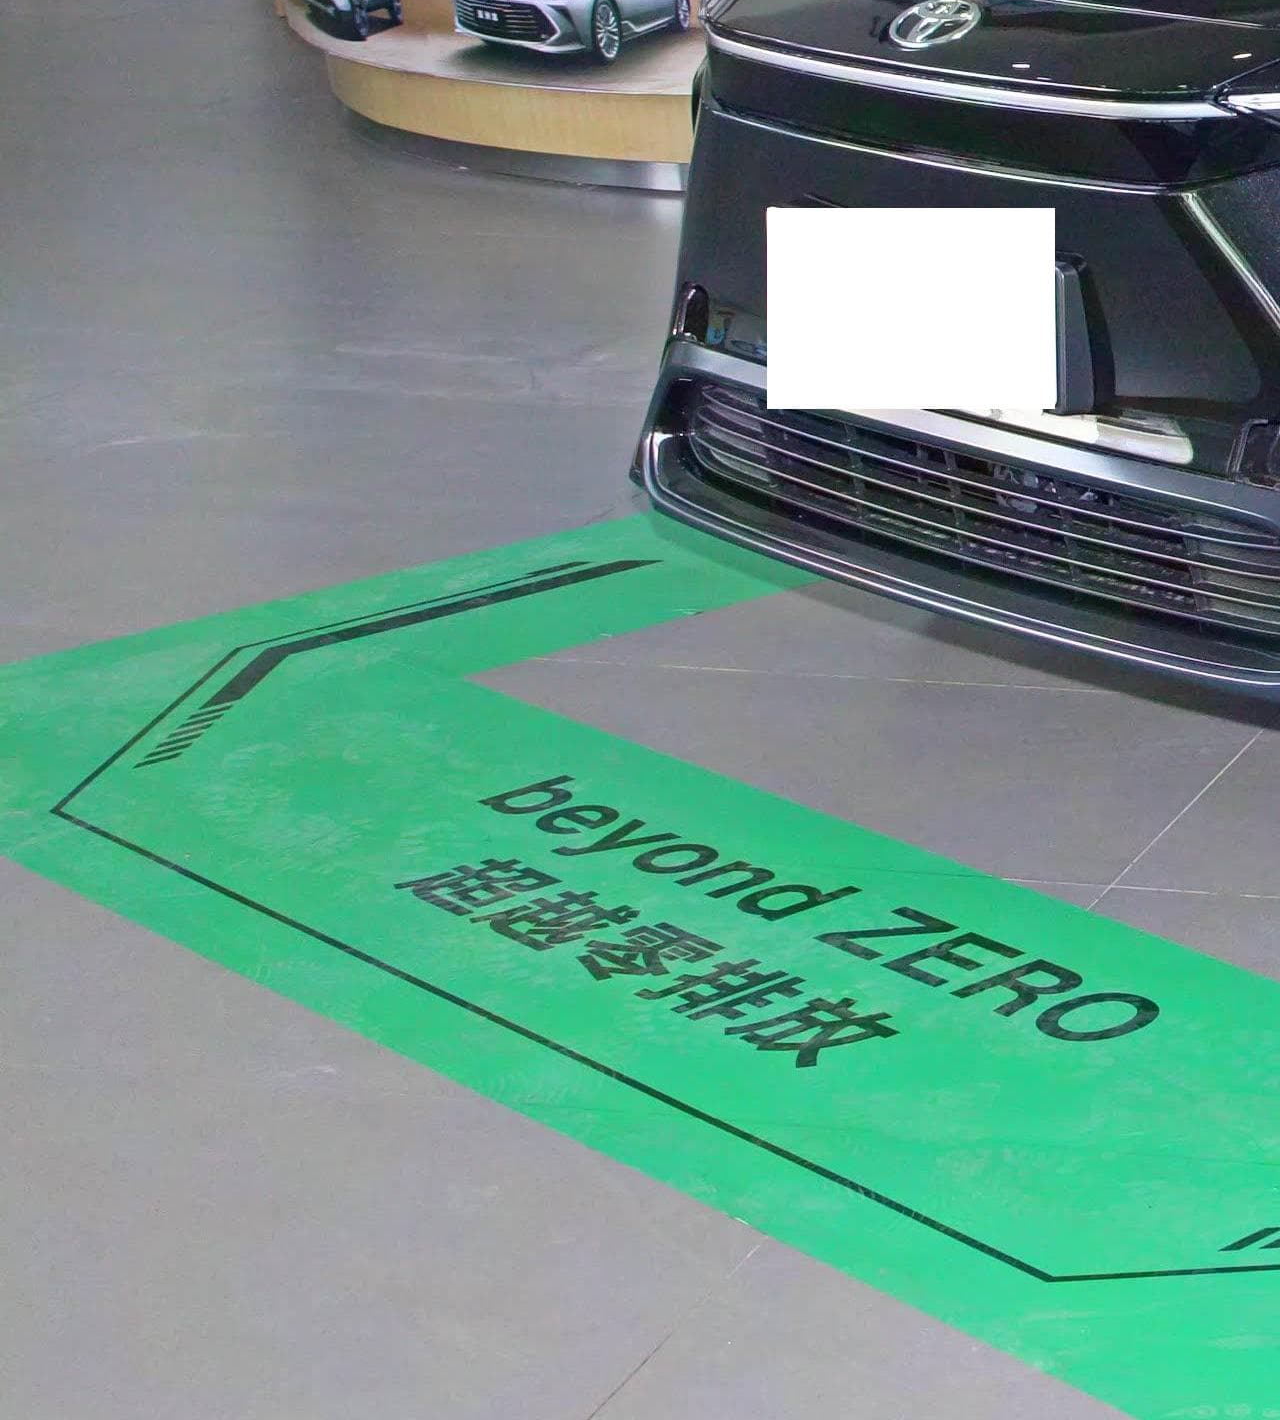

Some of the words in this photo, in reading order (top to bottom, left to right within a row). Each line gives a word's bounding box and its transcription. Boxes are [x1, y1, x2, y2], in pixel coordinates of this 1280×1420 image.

[393, 859, 901, 1069] 超越零排放
[478, 775, 862, 921] beyond
[814, 906, 1161, 1043] ZERO
